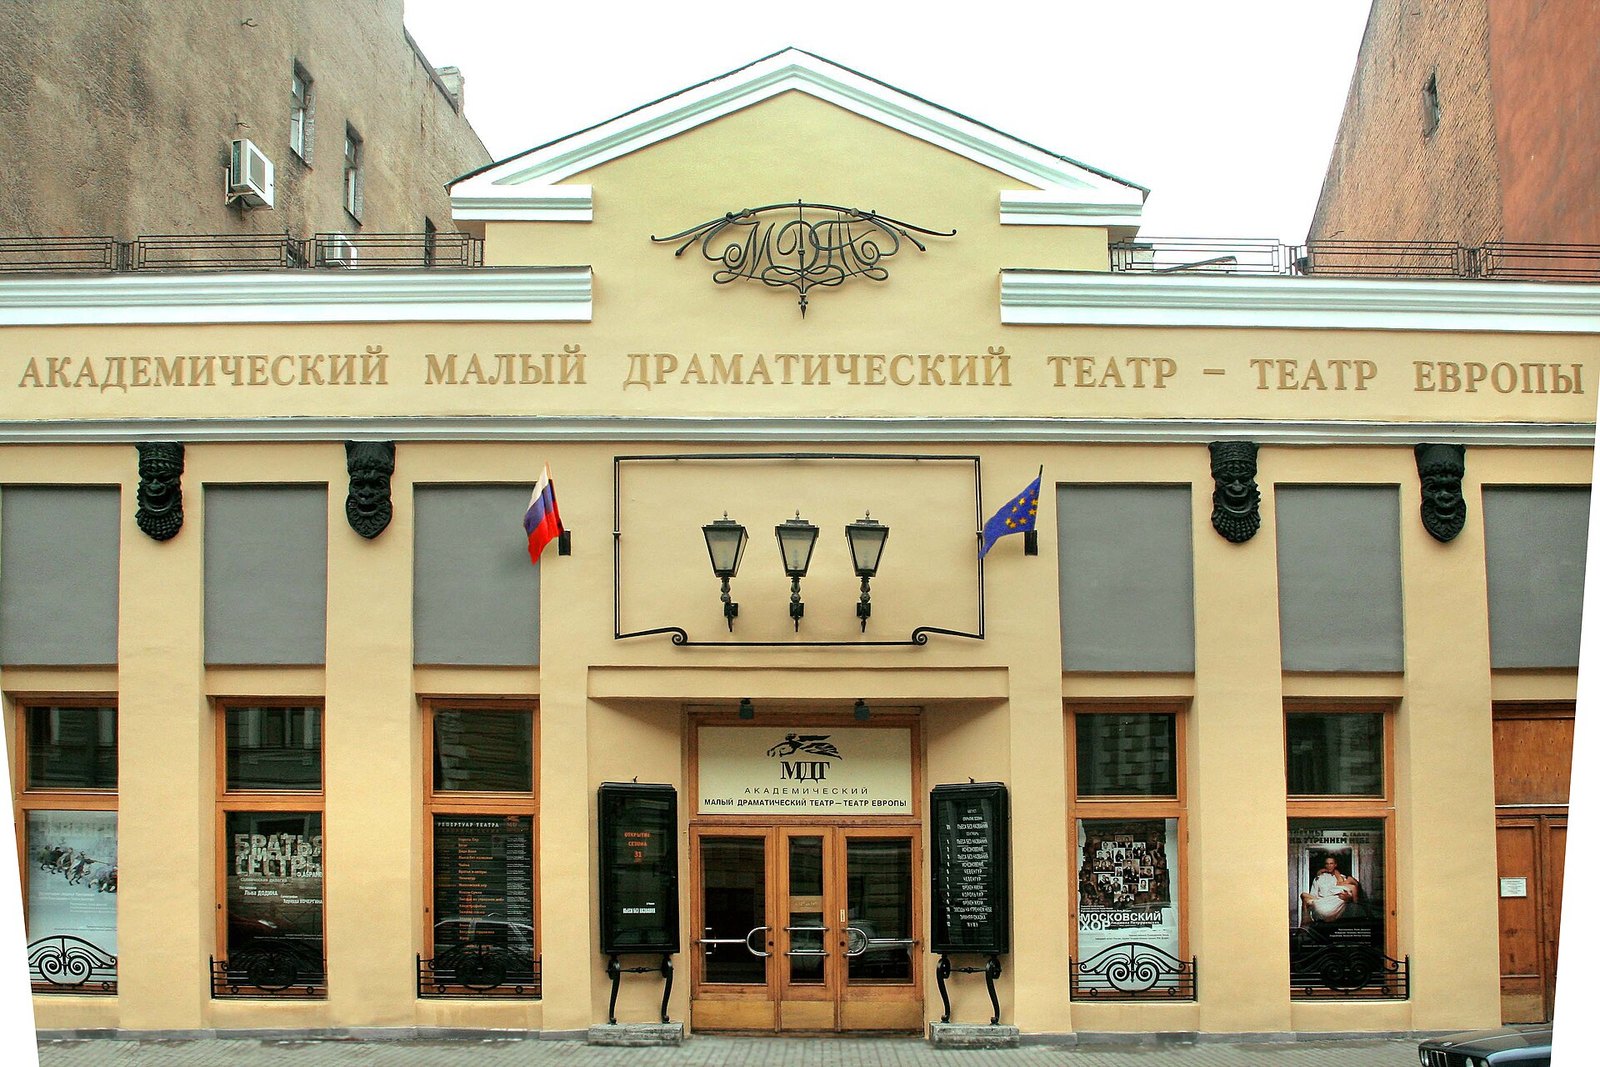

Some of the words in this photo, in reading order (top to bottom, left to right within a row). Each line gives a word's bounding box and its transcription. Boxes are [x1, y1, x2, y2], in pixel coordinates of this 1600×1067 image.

[18, 344, 389, 393] АКАДЕМИЧЕСКИЙ
[424, 344, 587, 385] МАЛЫЙ
[622, 345, 1012, 391] ДРАМАТИЧЕСКИЙ
[1047, 355, 1178, 388] ТЕАТР
[1250, 358, 1377, 390] ТЕАТР
[1412, 361, 1585, 394] ЕВРОПЫ
[780, 761, 830, 783] МДТ
[744, 786, 869, 795] АКАДЕМИЧЕСКИЙ
[704, 797, 734, 806] МАЛЫЙ
[737, 797, 807, 807] ДРАМАТИЧЕСКИЙ
[871, 799, 907, 807] ЕВРОПЫ
[634, 850, 643, 858] 31
[1080, 910, 1161, 921] МОСКОВСКИЙ
[1080, 920, 1111, 931] ХОР
